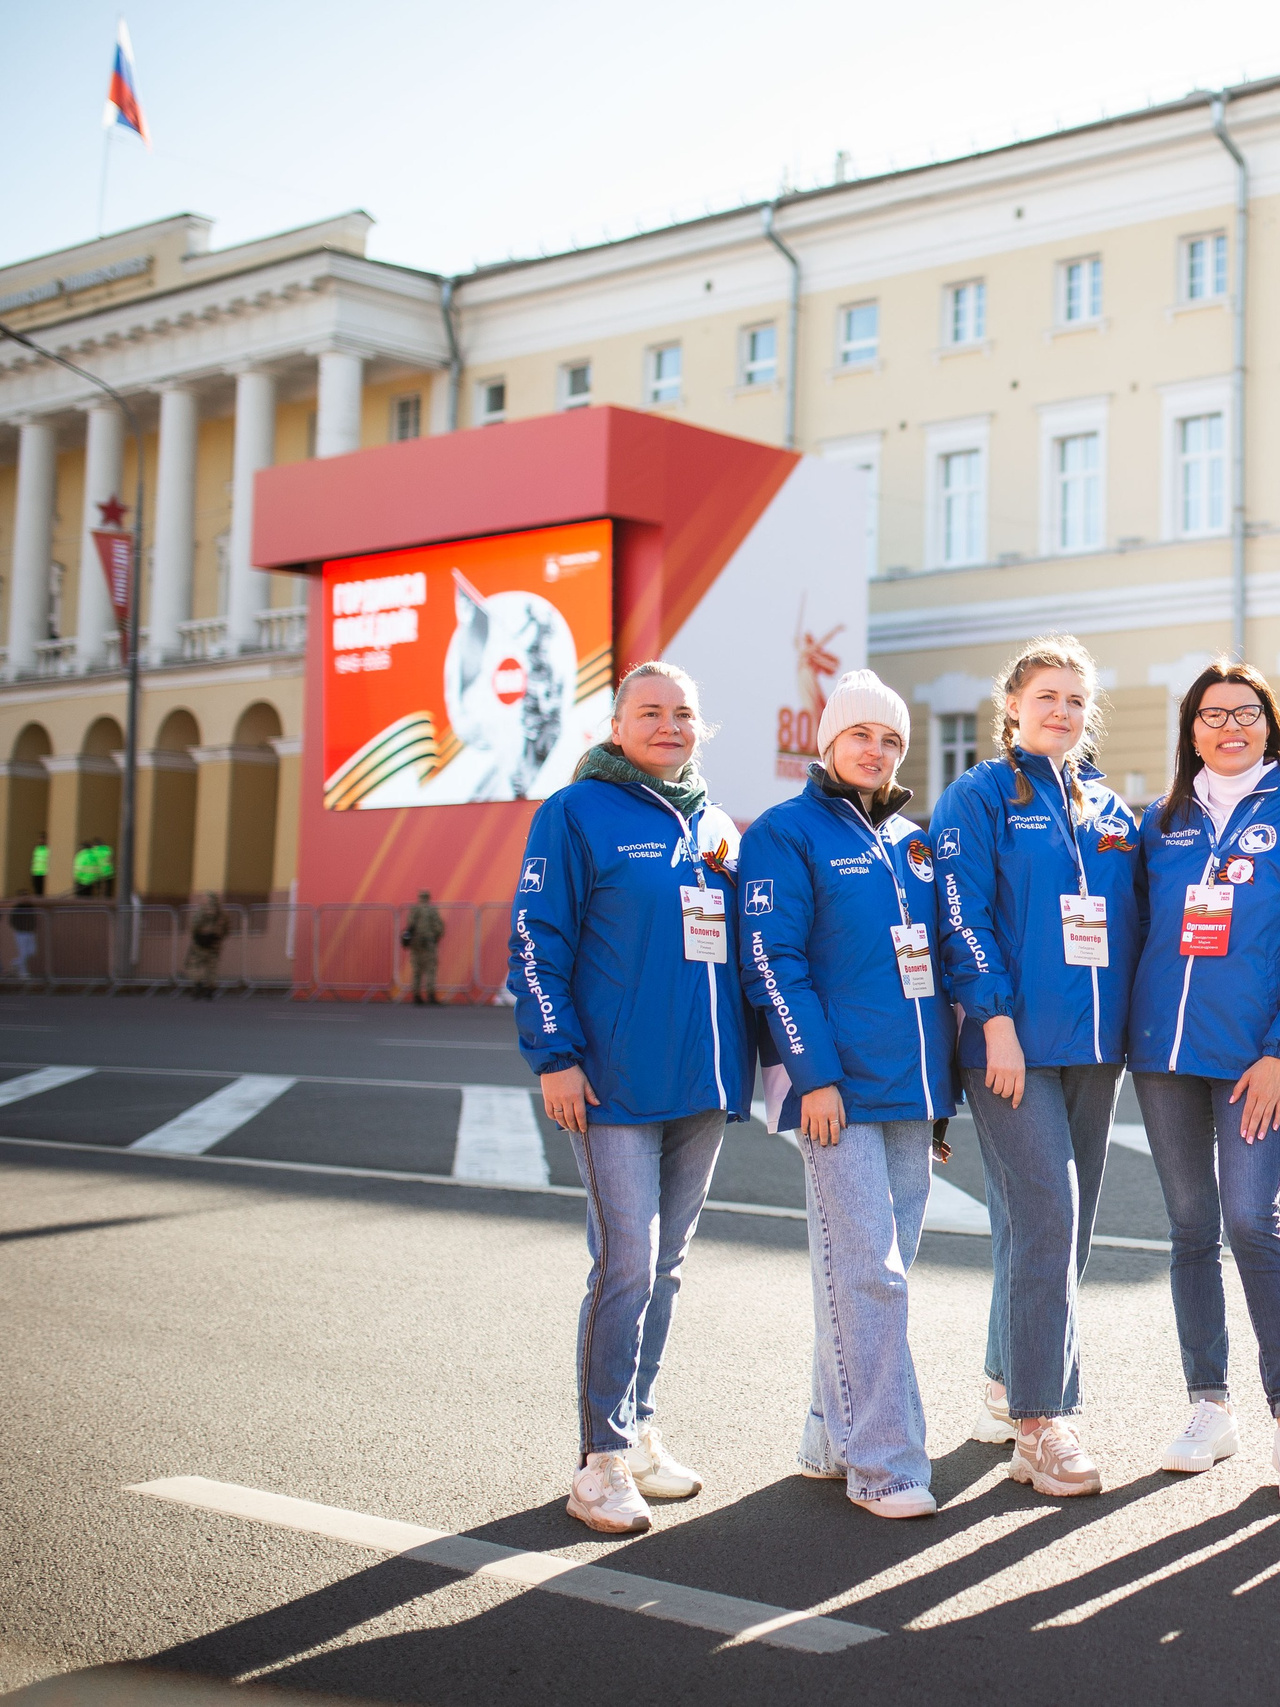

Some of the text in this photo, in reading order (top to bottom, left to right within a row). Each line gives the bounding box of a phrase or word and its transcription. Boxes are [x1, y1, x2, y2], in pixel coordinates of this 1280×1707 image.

[777, 706, 812, 751] 80
[1014, 822, 1048, 830] ПОБЕДЫ
[617, 841, 667, 852] ВОЛОНТЁРЫ
[1165, 839, 1195, 847] ПОБЕДЫ
[628, 851, 663, 859] ПОБЕДЫ
[830, 856, 873, 867] ВОЛОНТЁРЫ
[839, 866, 870, 876] ПОБЕДЫ
[690, 925, 721, 938] Волонтёр
[1186, 922, 1227, 932] Оргкомитет
[1070, 933, 1102, 944] Волонтёр
[904, 962, 928, 973] Волонтёр
